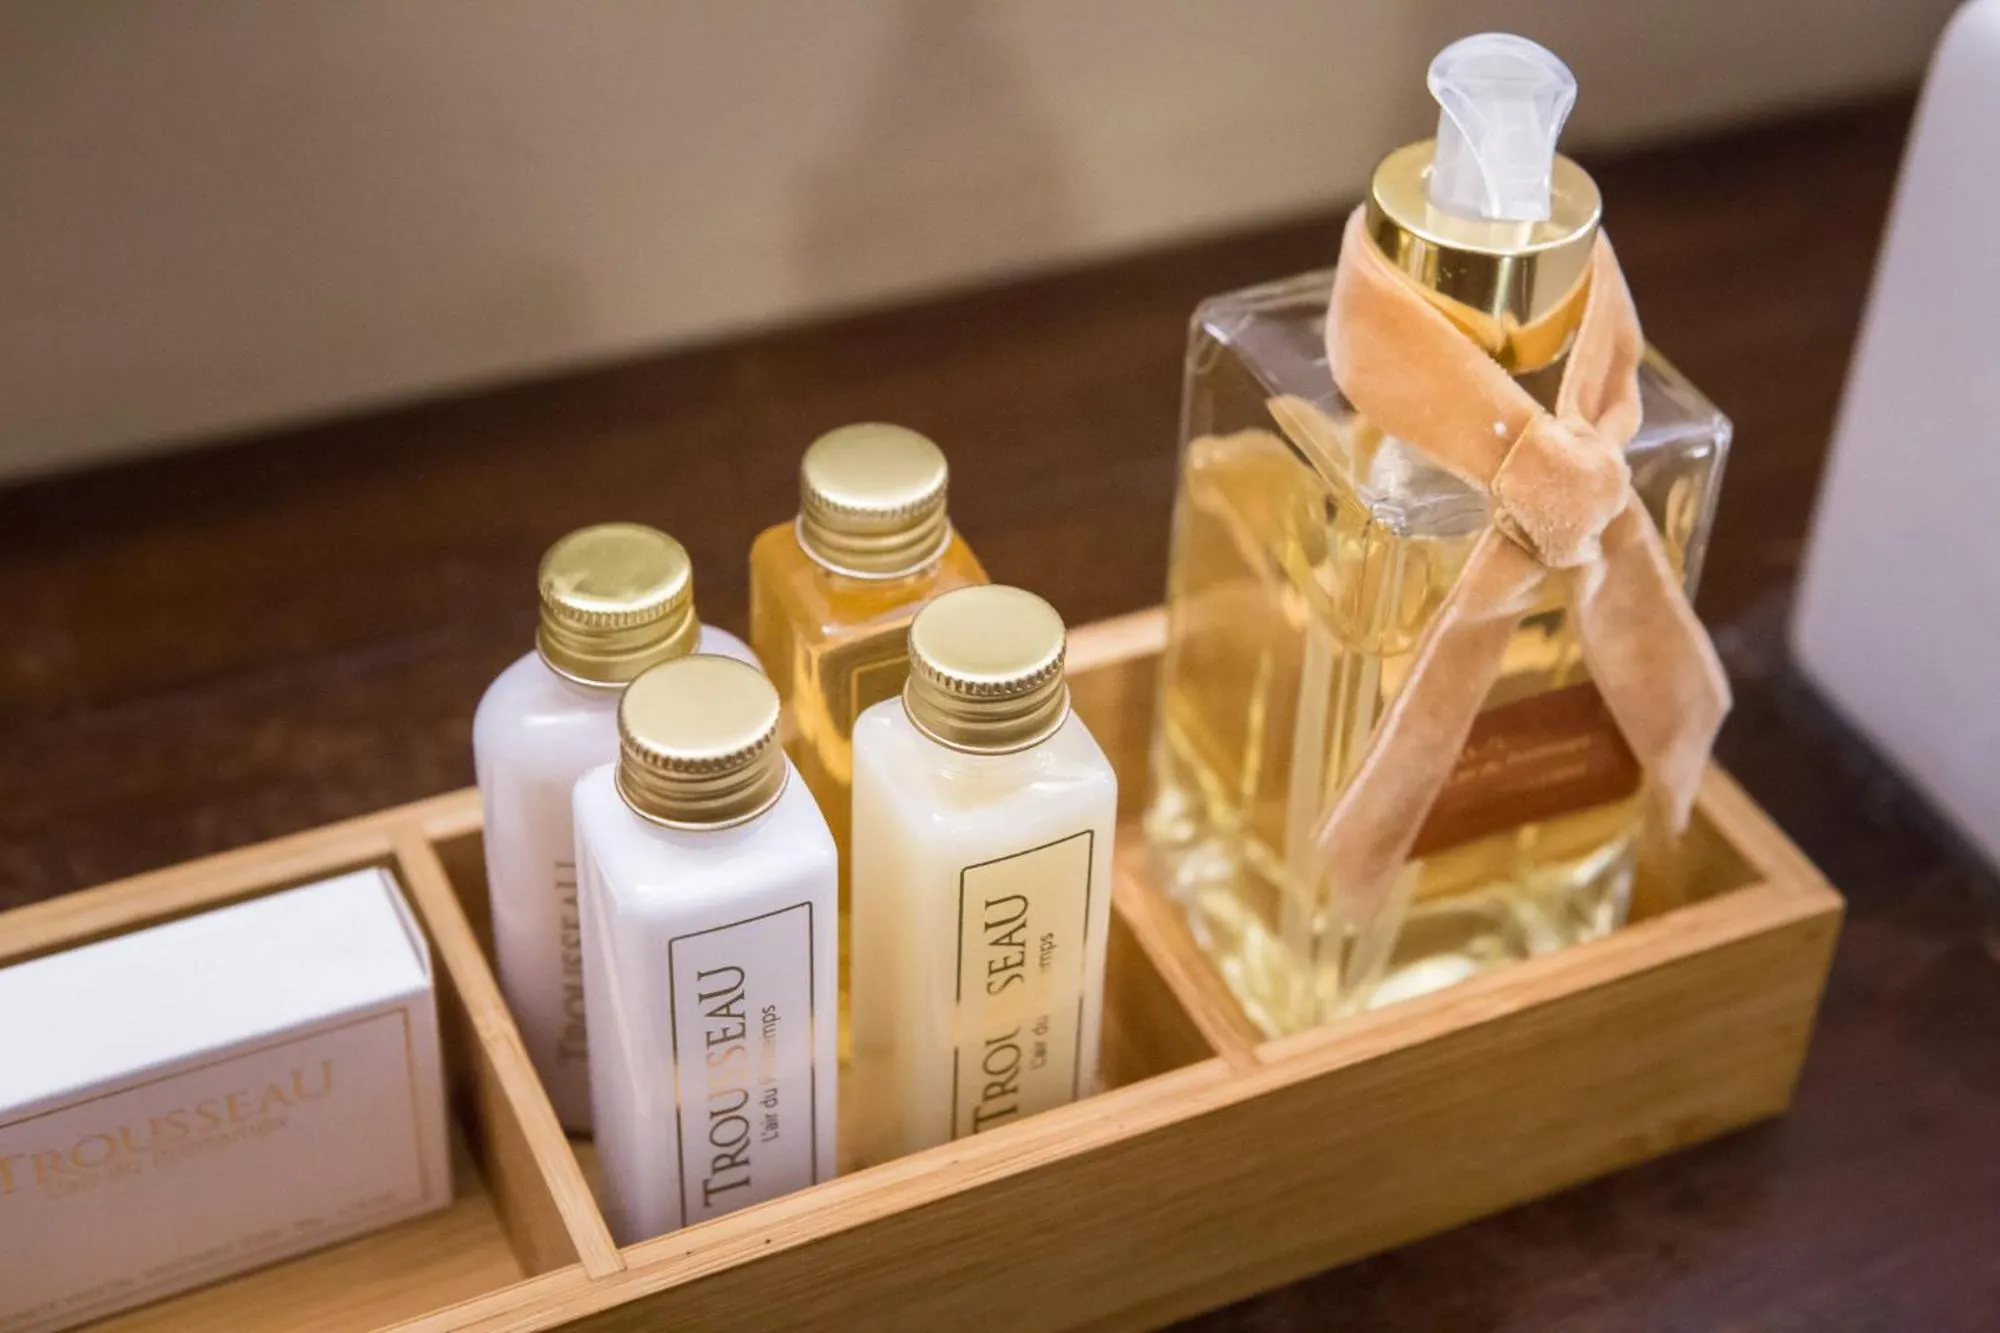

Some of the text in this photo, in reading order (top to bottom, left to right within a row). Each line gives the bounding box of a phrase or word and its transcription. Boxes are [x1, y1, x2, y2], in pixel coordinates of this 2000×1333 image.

[758, 1087, 779, 1109] du
[0, 1059, 334, 1195] TROUSSEAU
[758, 1114, 779, 1143] L'air
